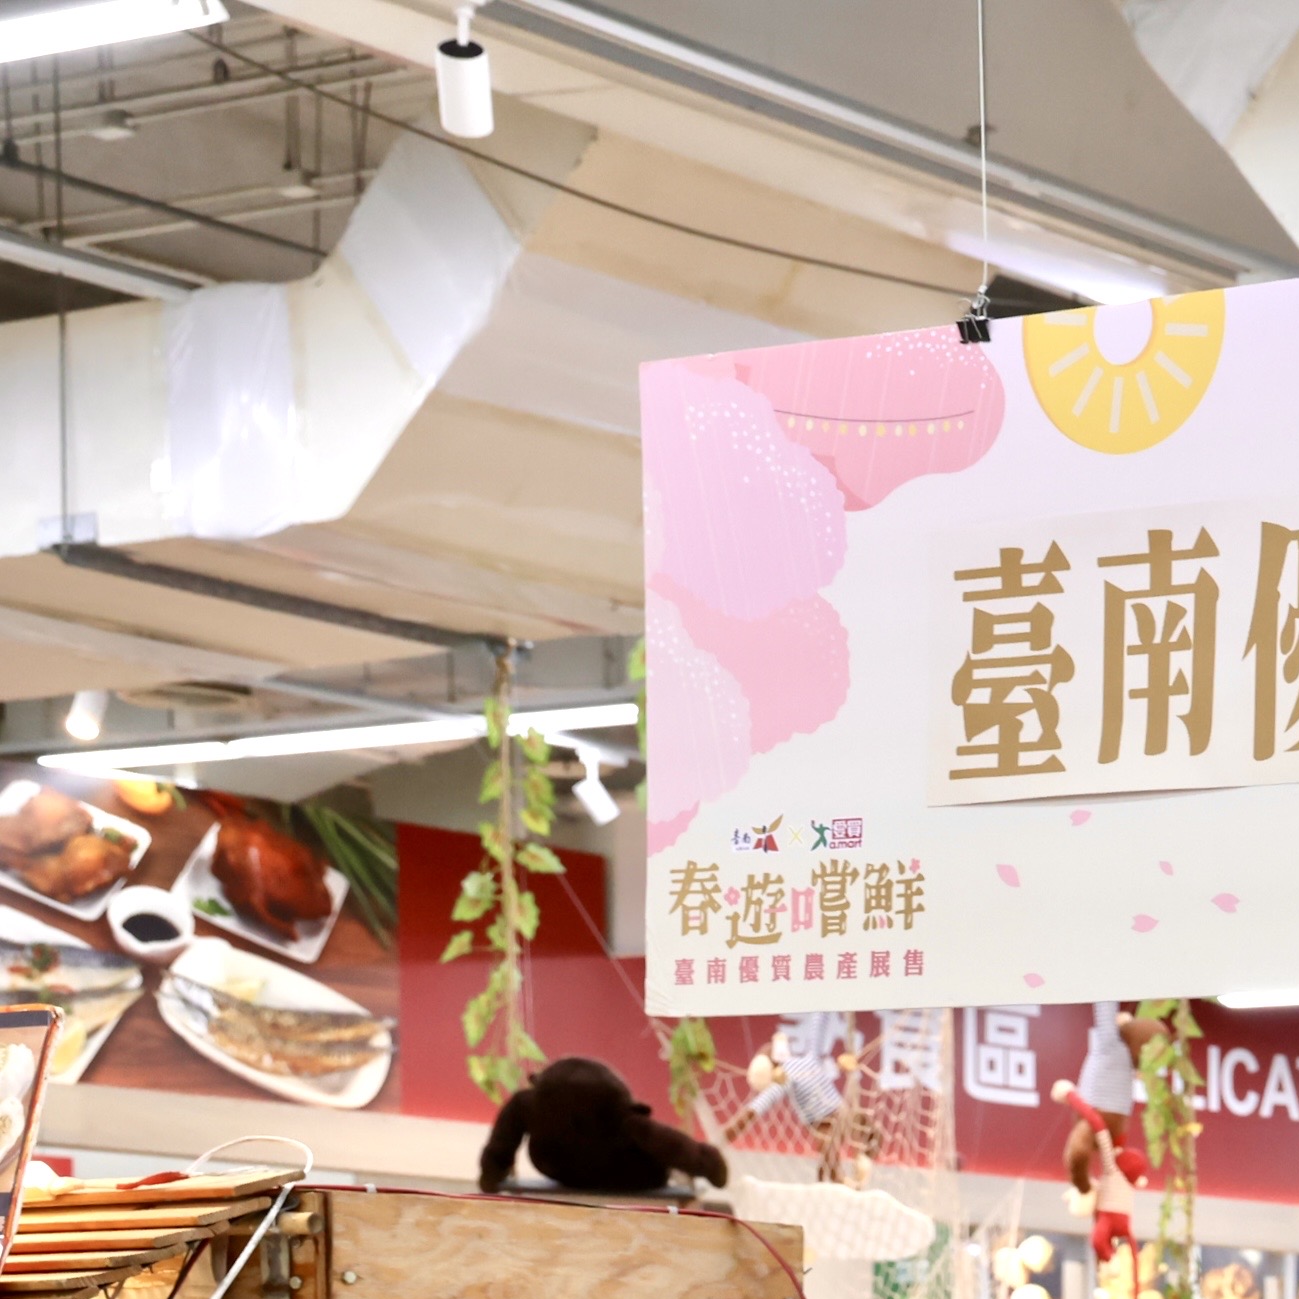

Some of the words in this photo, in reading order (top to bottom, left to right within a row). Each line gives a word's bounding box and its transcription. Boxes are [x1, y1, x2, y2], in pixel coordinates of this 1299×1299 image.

[669, 859, 925, 949] 春遊嚐鮮
[674, 950, 924, 985] 臺南優質農產展售
